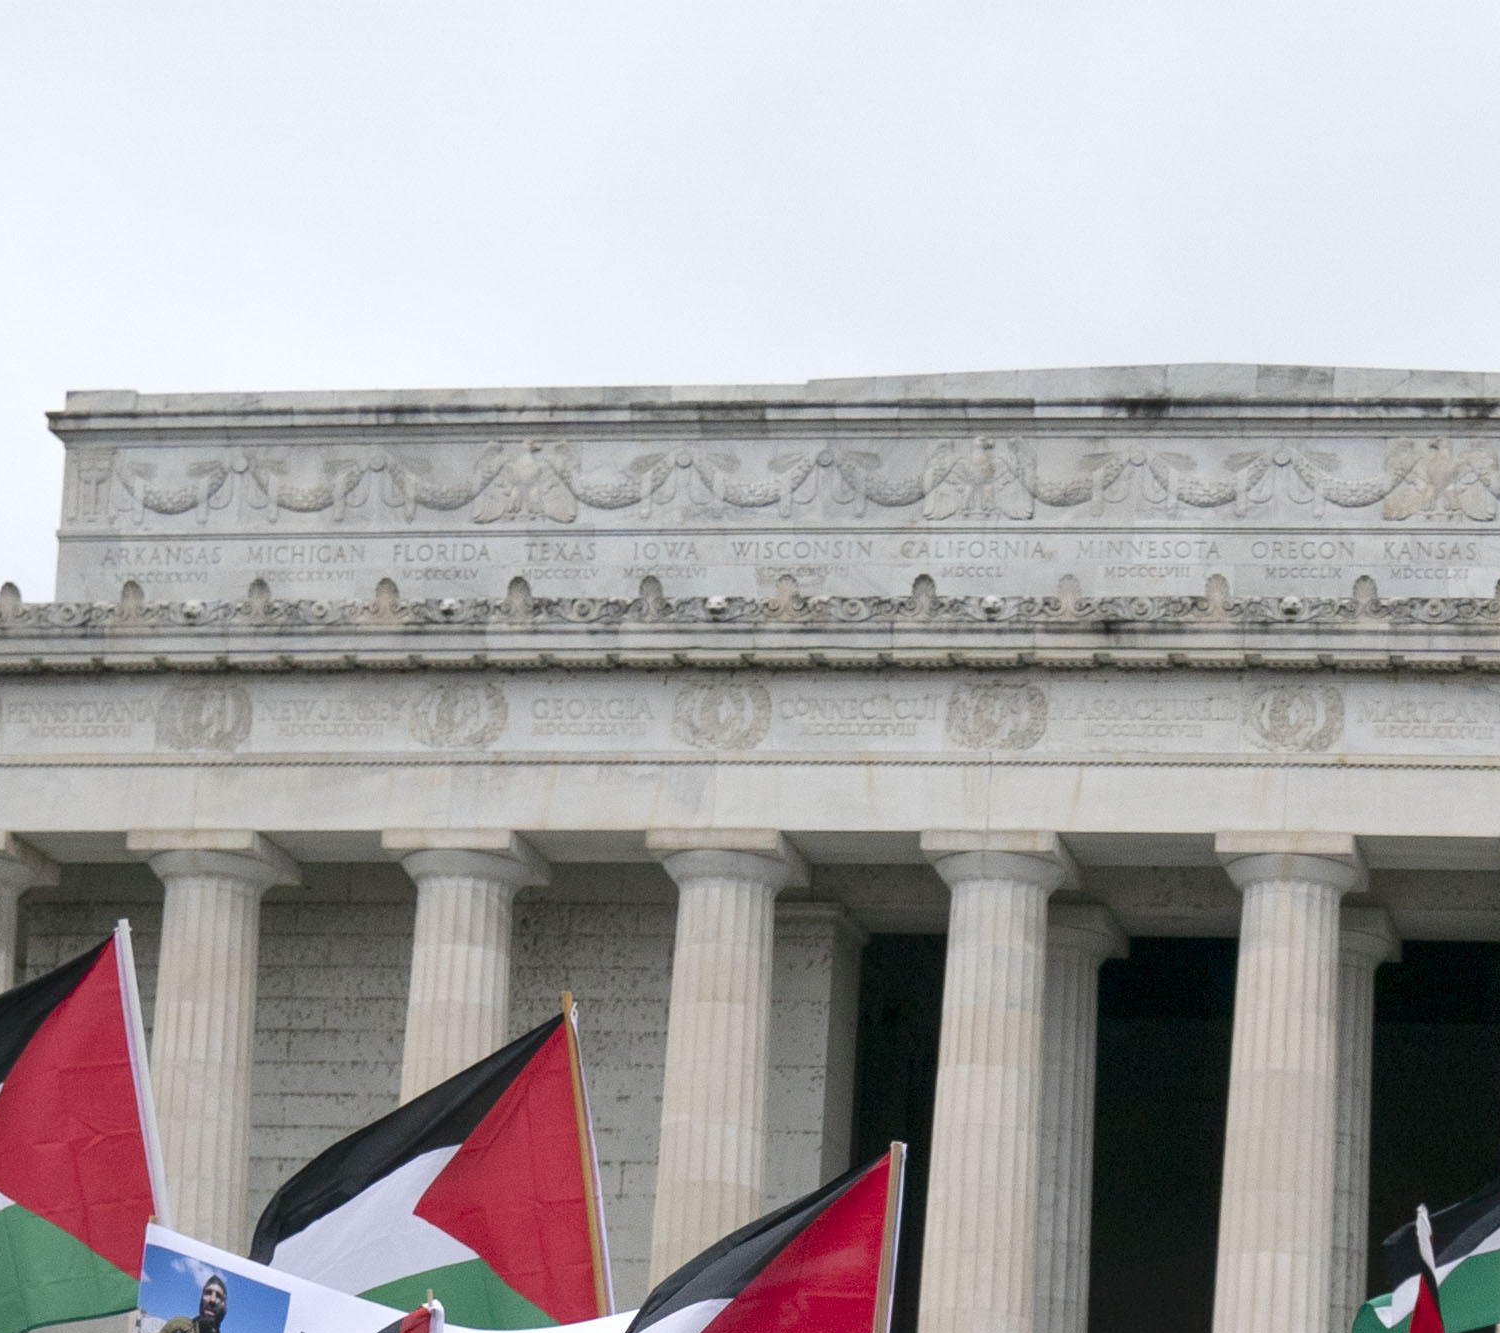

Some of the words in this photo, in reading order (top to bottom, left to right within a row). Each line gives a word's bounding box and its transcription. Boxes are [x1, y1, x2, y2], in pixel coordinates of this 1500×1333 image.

[103, 546, 222, 567] ARKANSAS
[247, 545, 366, 565] MICHIGAN
[393, 544, 491, 564] FLORIDA
[525, 543, 597, 562] TEXAS
[632, 542, 699, 560] IOWA
[731, 540, 873, 560] WISCONSIN
[900, 540, 1046, 560] CALIFORNIA
[1076, 540, 1222, 560] MINNESOTA
[1251, 540, 1356, 560] OREGON
[1383, 541, 1477, 561] KANSAS
[532, 698, 653, 721] GEORGIA
[779, 697, 938, 721] CONNECTICUT
